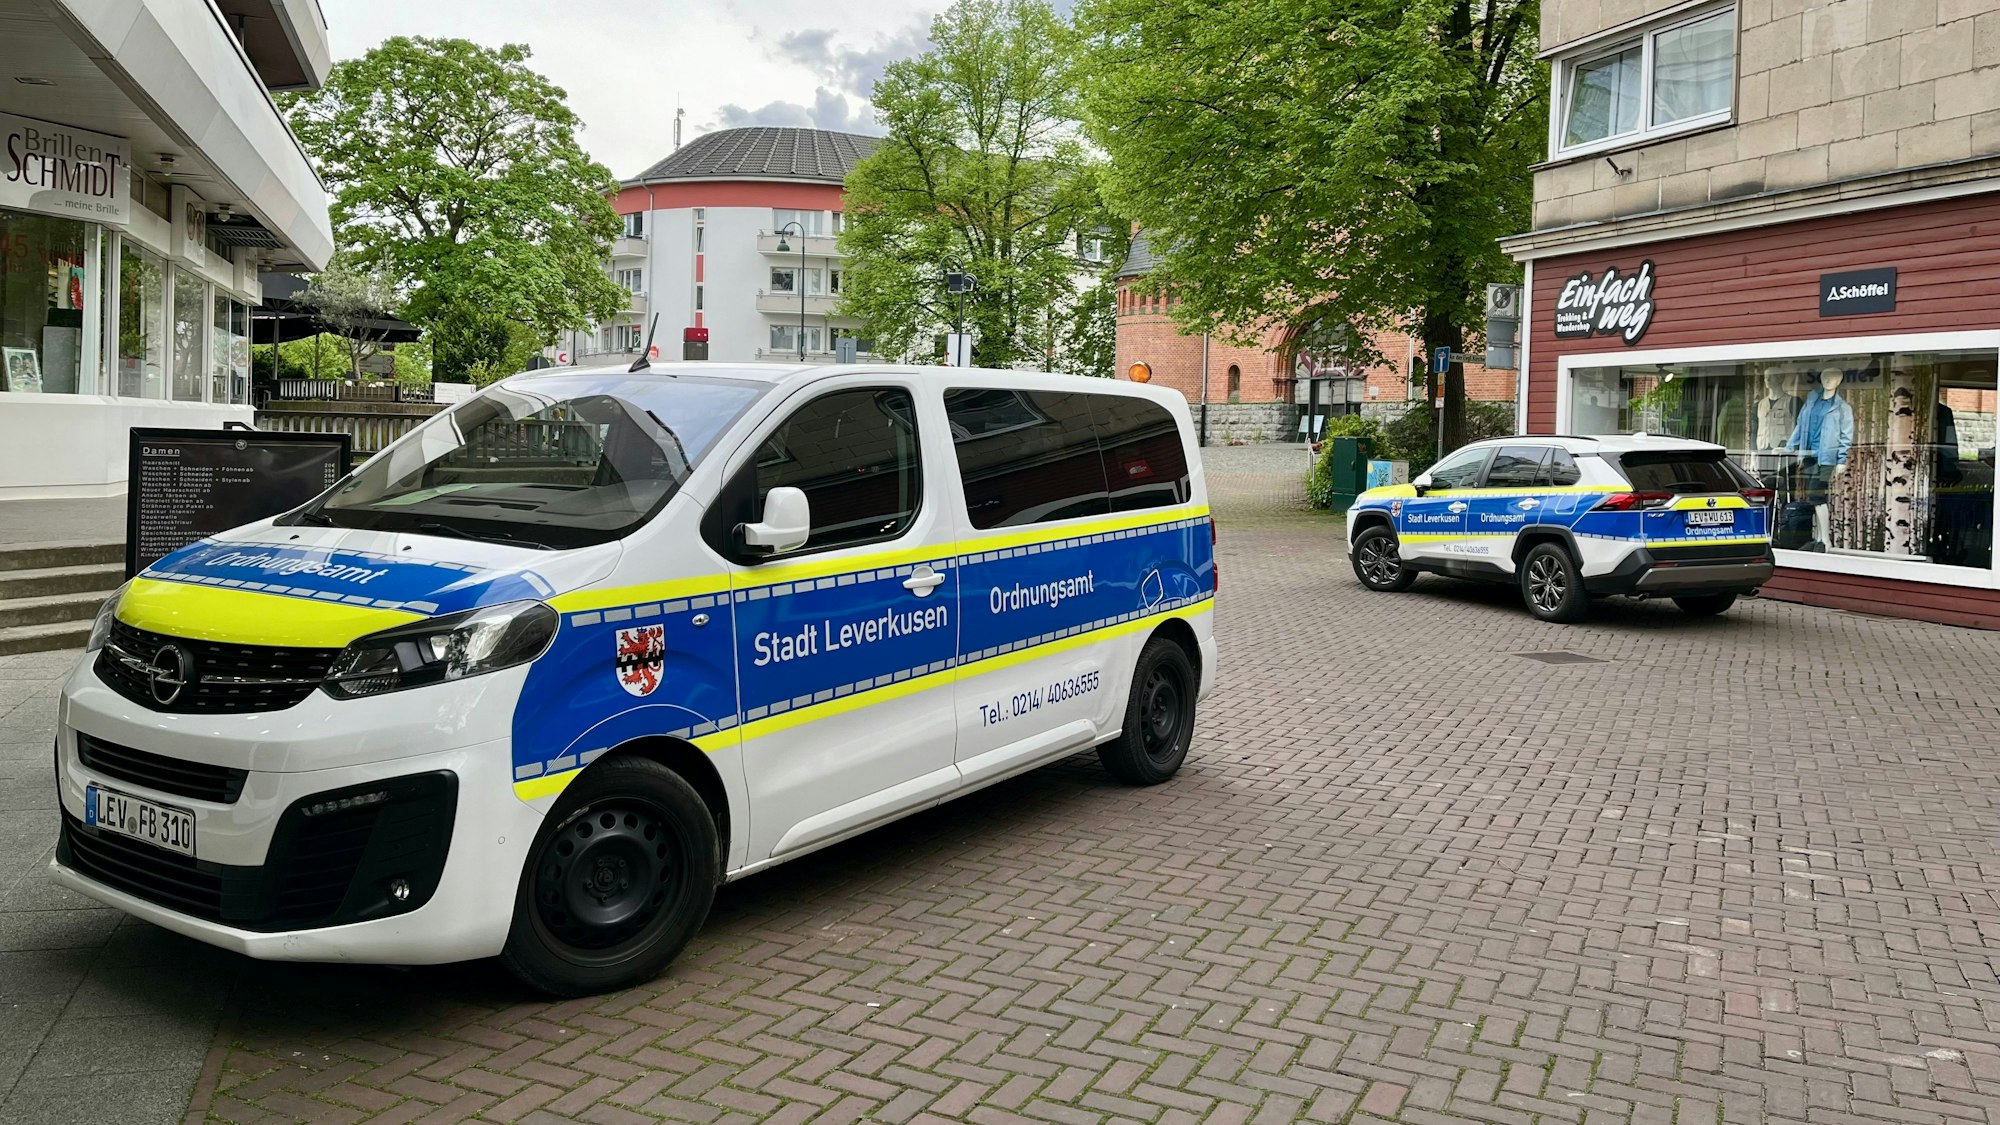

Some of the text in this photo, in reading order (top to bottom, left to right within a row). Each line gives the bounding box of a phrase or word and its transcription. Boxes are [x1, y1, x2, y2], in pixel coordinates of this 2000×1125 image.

[23, 127, 101, 163] Brillen
[7, 133, 121, 199] SCHMIDT
[65, 200, 93, 211] meine
[96, 203, 120, 215] Brille
[1557, 263, 1651, 319] Einfach
[1839, 282, 1889, 299] Schöffel
[1557, 311, 1588, 322] Trekking &
[1557, 322, 1590, 332] Wandershop
[1598, 302, 1651, 340] weg
[142, 446, 180, 455] Damen
[1408, 513, 1460, 523] Stadt Leverkusen
[1480, 513, 1526, 525] Ordnungsamt
[1689, 511, 1733, 523] LEV WU 613
[1685, 526, 1734, 536] Ordnungsamt
[205, 552, 389, 584] Ordnungsamt
[990, 569, 1095, 614] Ordnungsamt
[753, 604, 948, 667] Stadt Leverkusen
[979, 670, 1099, 727] Tel.: 0214/ 40636555
[97, 793, 190, 849] LEV FB 310
